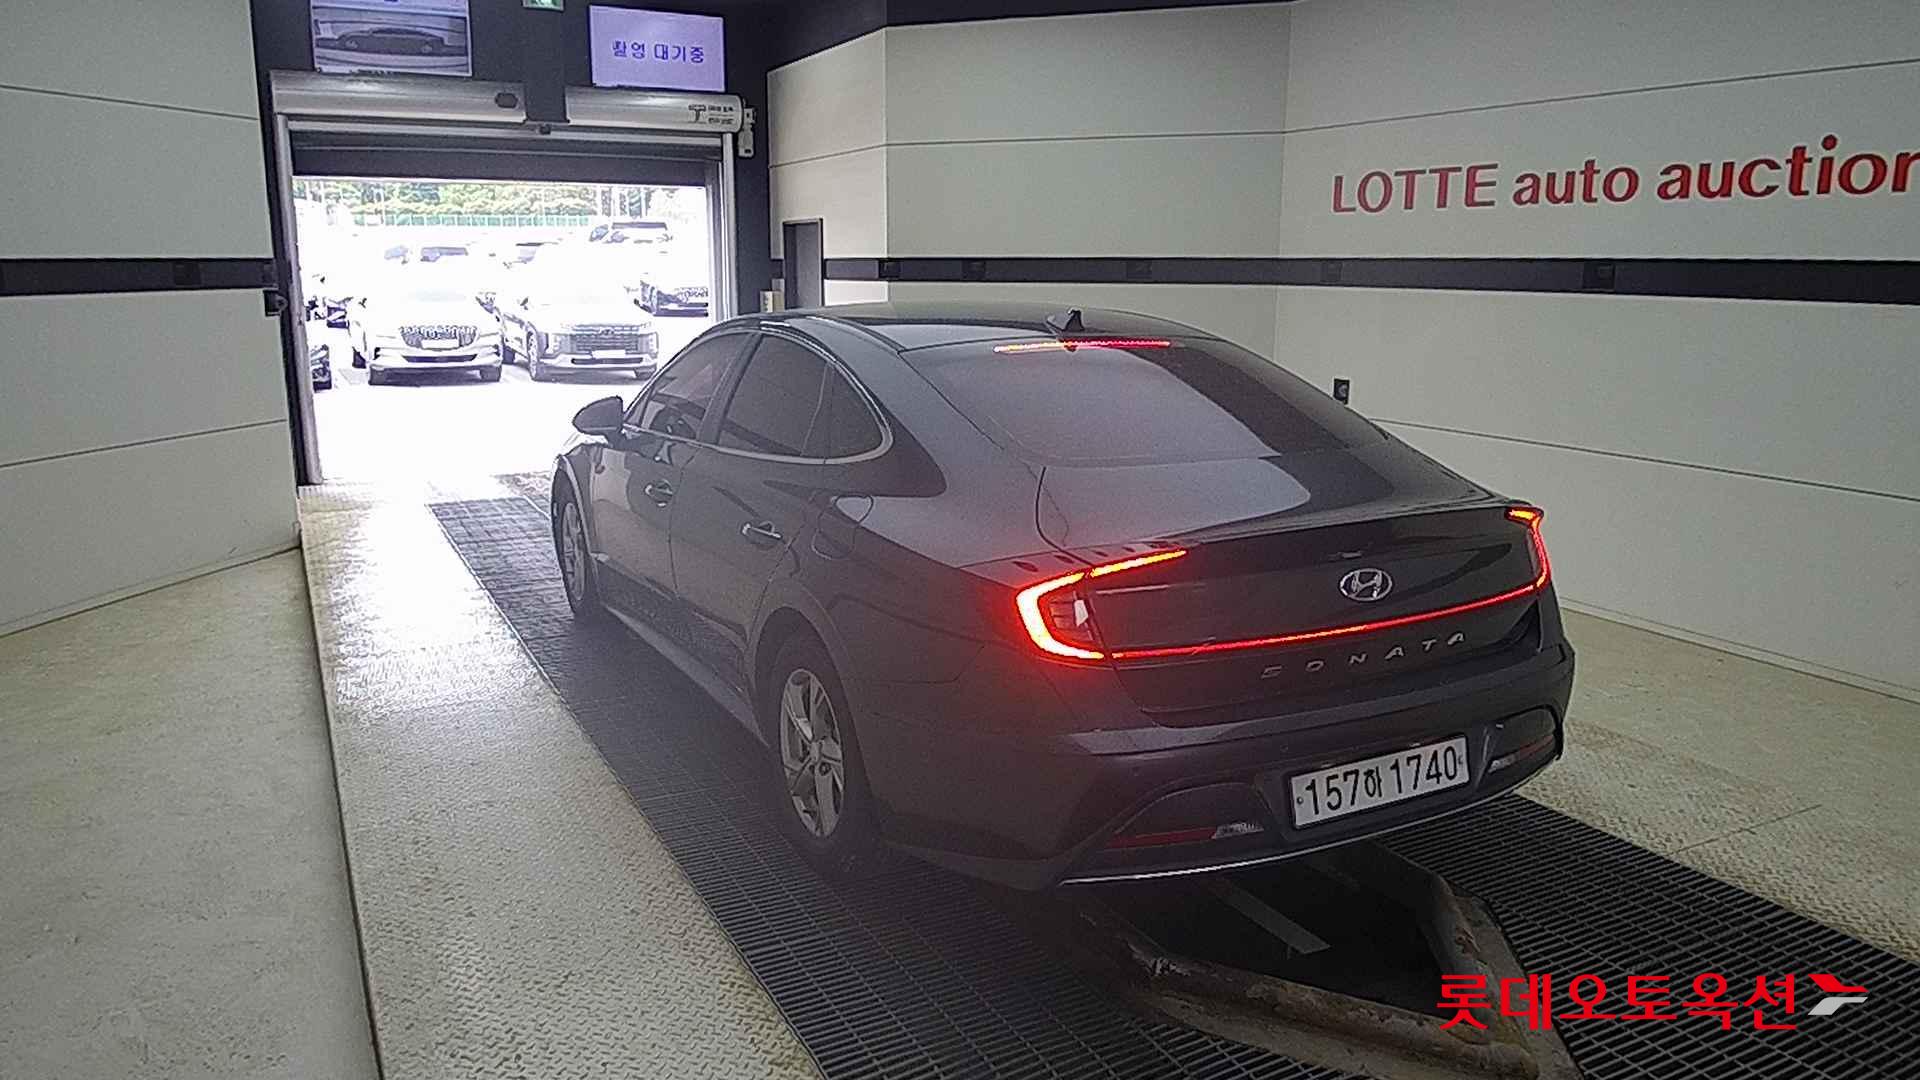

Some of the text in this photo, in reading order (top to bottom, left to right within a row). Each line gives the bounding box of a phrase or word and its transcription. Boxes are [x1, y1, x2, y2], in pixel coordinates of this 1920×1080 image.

[654, 43, 705, 64] 대기중
[1332, 163, 1499, 213] LOTTE
[1512, 159, 1640, 206] auto
[1260, 632, 1466, 680] SONATA
[1305, 746, 1458, 816] 157하 1740
